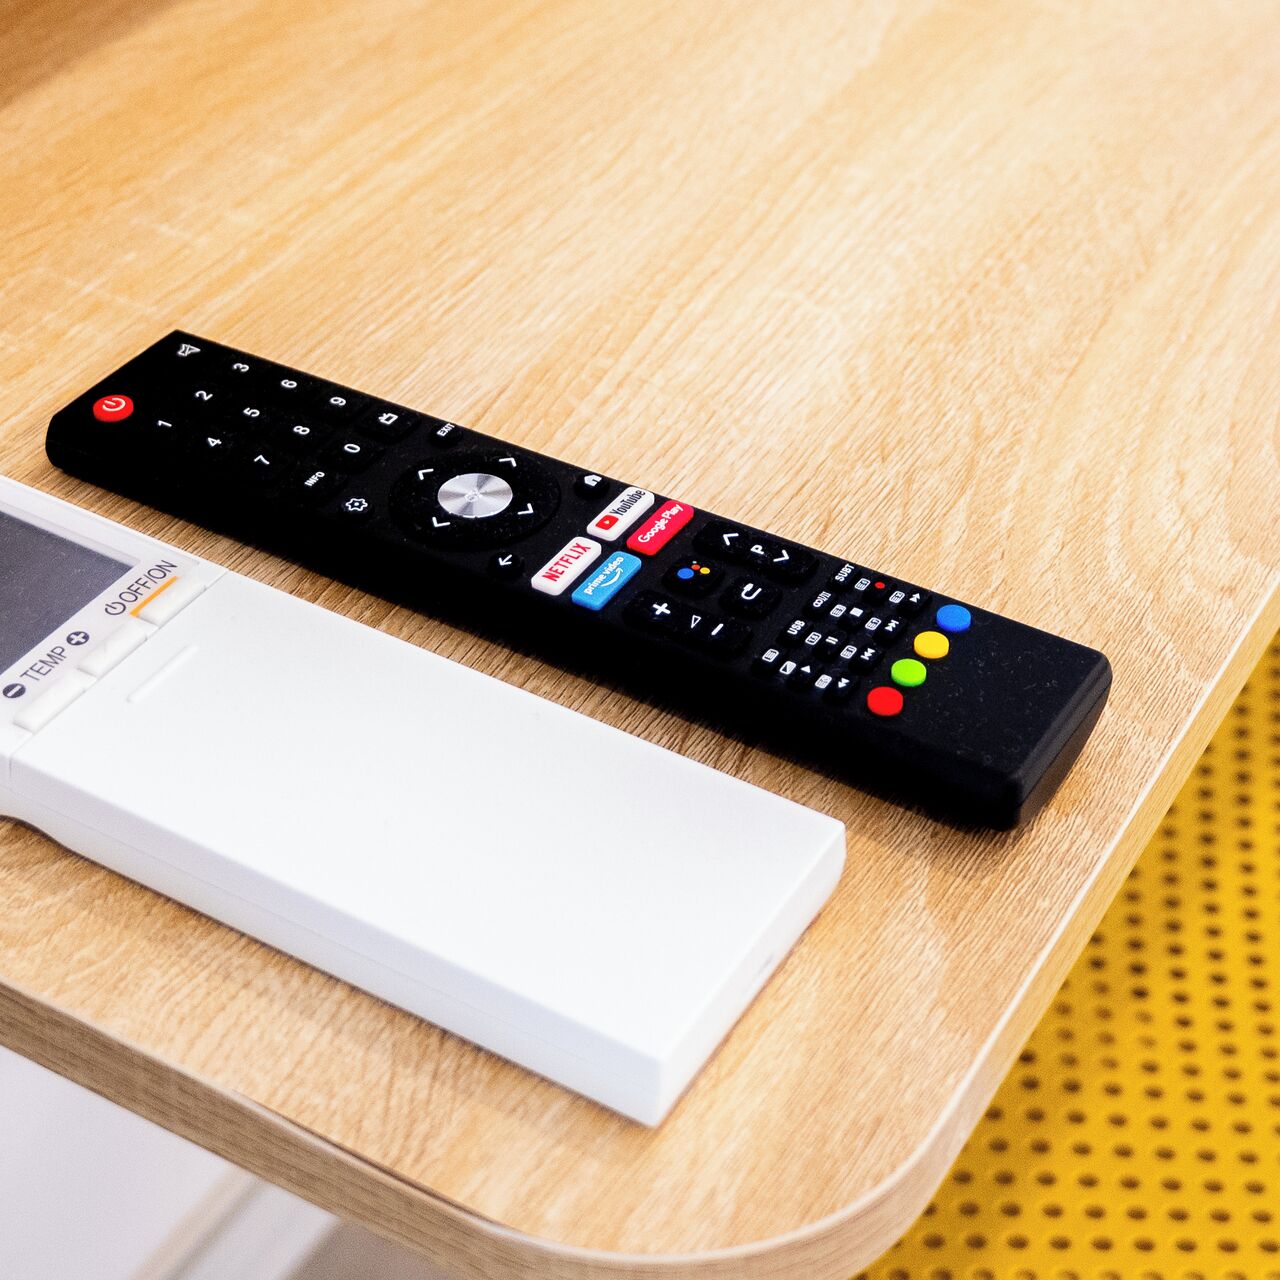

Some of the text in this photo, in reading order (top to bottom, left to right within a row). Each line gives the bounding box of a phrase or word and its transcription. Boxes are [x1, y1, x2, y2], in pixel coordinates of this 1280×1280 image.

[232, 362, 250, 372] 3
[280, 379, 298, 389] 6
[194, 390, 213, 401] 2
[329, 396, 346, 406] 9
[243, 407, 260, 418] 5
[157, 419, 172, 428] 1
[293, 425, 310, 435] 8
[436, 422, 455, 437] EXIT
[207, 436, 222, 447] 4
[343, 442, 361, 453] 0
[253, 454, 270, 465] 7
[304, 470, 325, 487] INFO
[609, 488, 646, 517] YouTube
[637, 503, 684, 543] Google Play
[750, 544, 765, 555] P
[542, 541, 592, 582] NETFLIX
[583, 556, 625, 596] prime video
[834, 563, 855, 582] SUBT
[118, 559, 179, 604] OFF/ON
[786, 619, 806, 635] USB
[19, 644, 68, 681] TEMP
